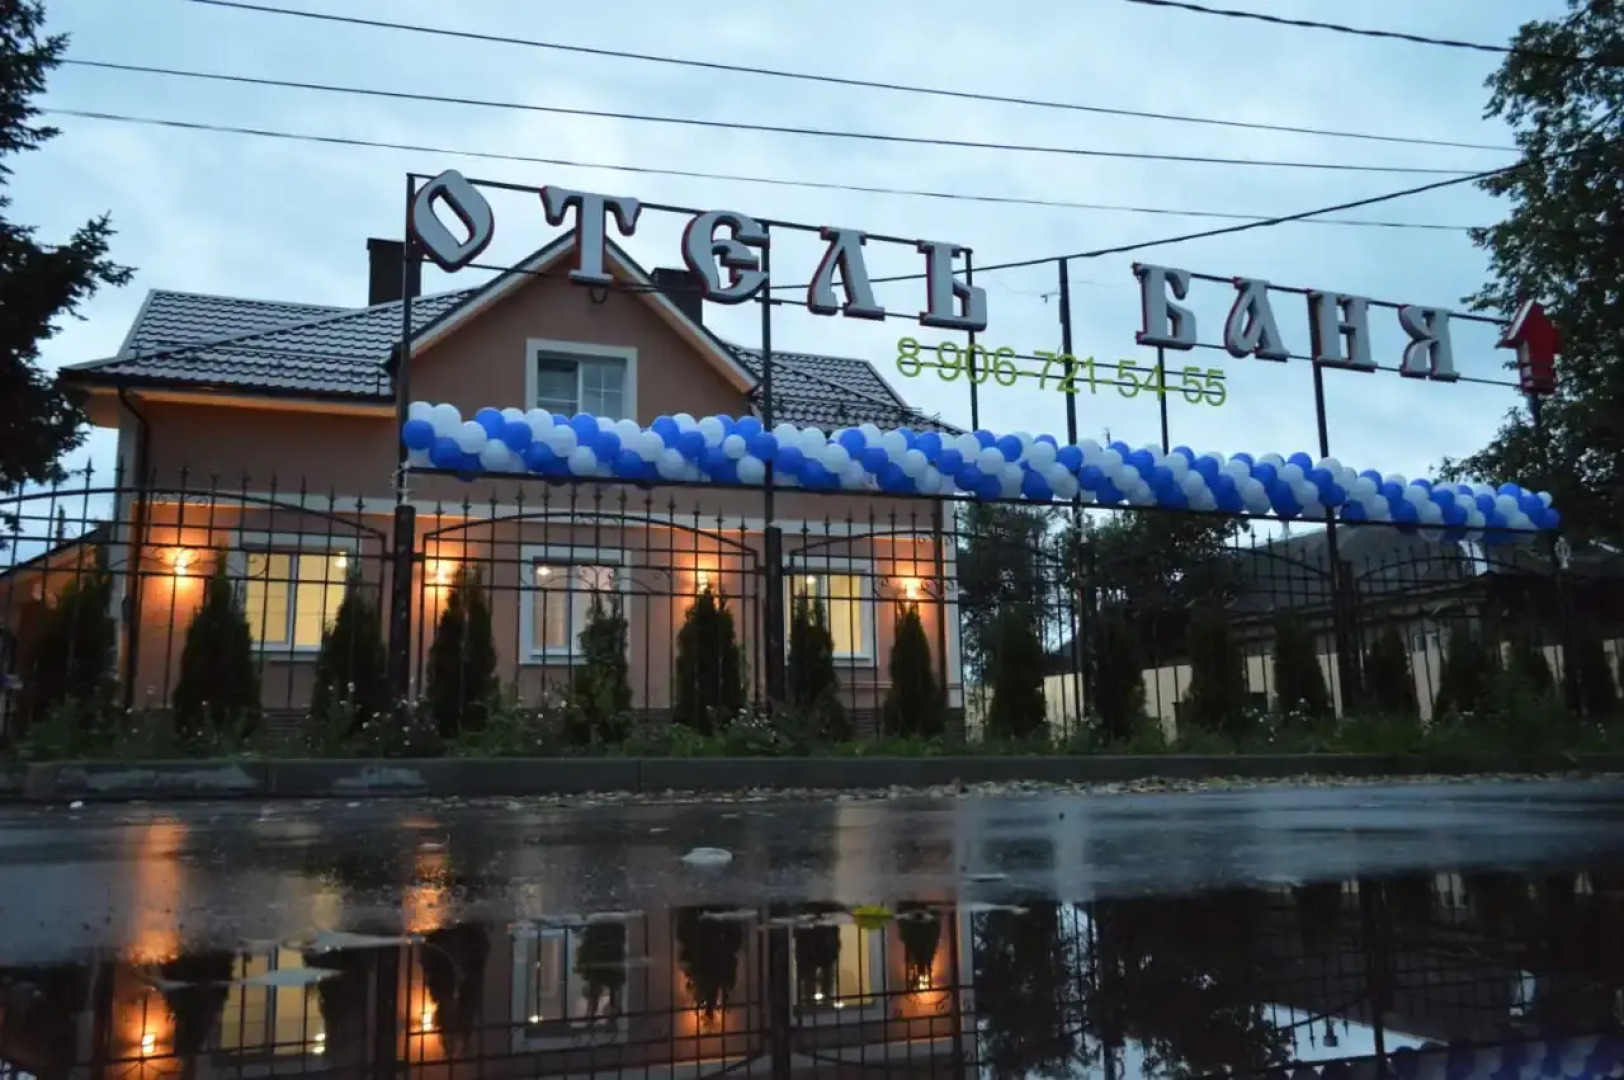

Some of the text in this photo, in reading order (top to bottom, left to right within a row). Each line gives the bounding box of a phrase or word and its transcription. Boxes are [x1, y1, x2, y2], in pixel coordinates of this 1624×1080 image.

[411, 169, 1460, 381] ОТЕЛЬ БАНЯ
[896, 337, 1227, 406] 8-906-721-54-55
